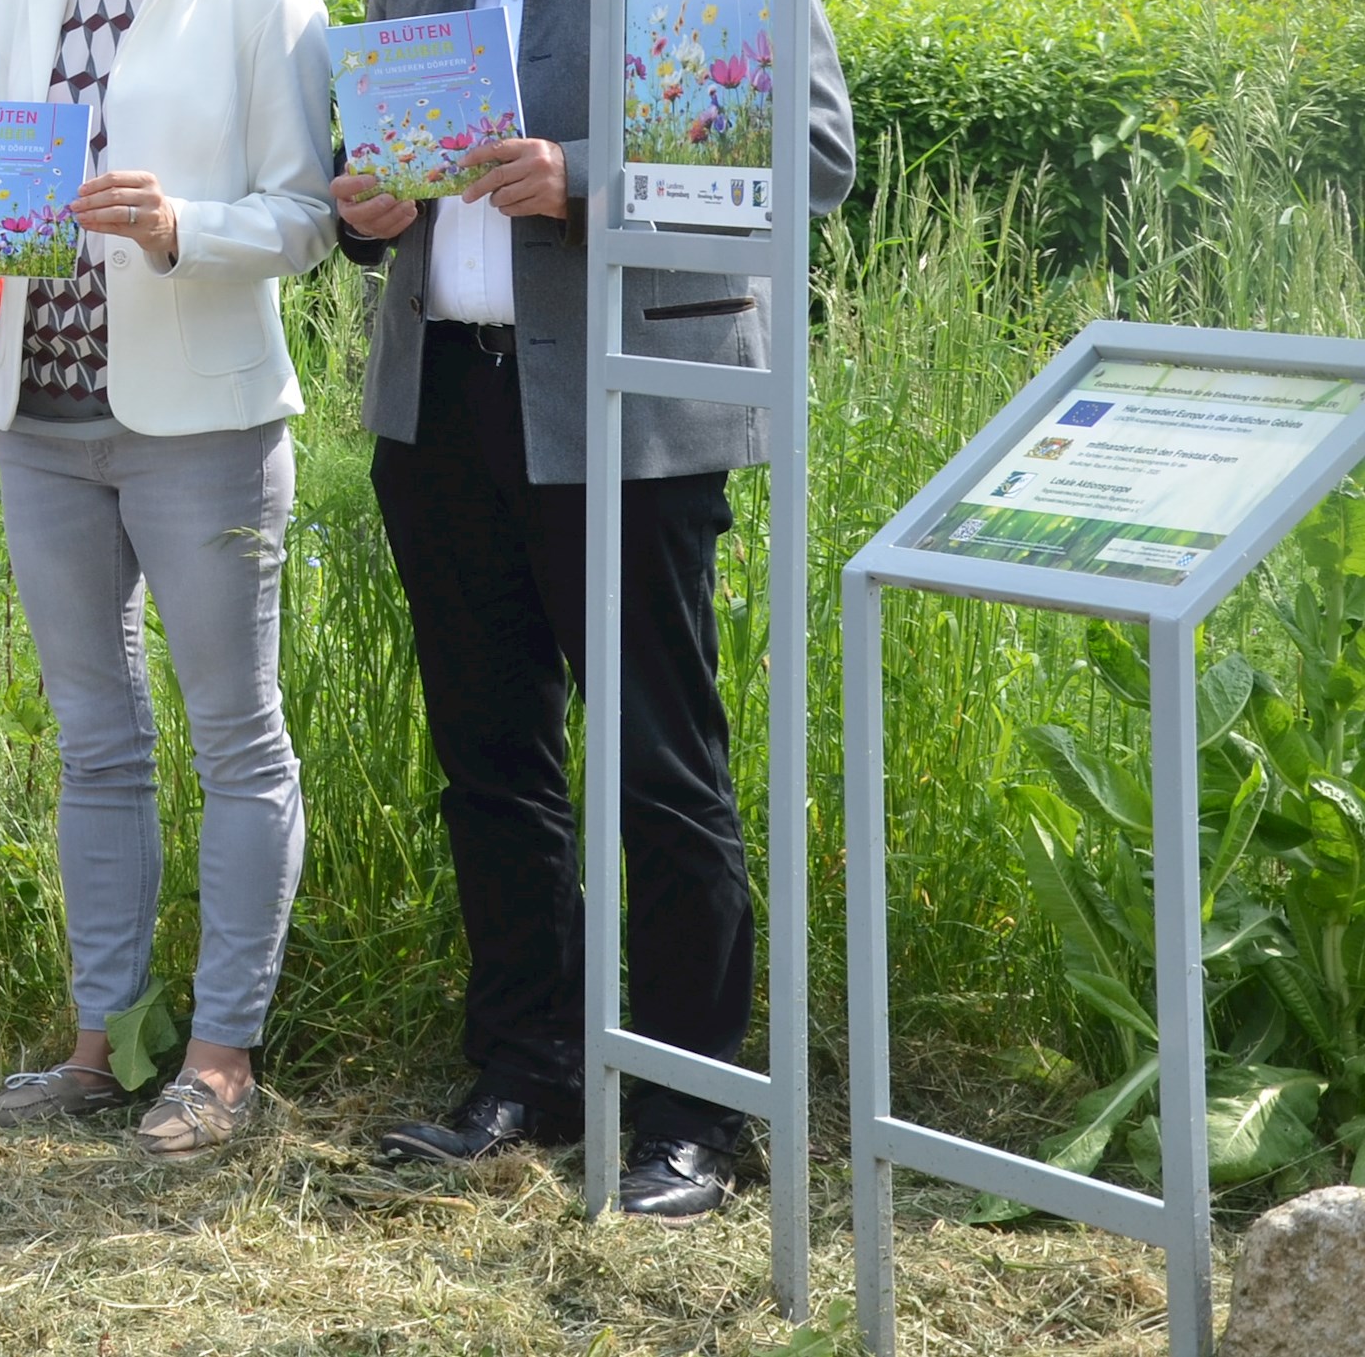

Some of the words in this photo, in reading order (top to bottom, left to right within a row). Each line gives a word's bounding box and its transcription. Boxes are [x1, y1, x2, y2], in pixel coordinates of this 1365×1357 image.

[379, 23, 452, 44] BLÜTEN
[384, 40, 454, 62] ZAUBER
[386, 64, 424, 74] UNSEREN
[426, 58, 467, 69] DÖRFERN
[8, 144, 44, 154] DÖRFERN
[1122, 404, 1140, 413] Hier
[1140, 406, 1177, 416] investiert
[1176, 410, 1206, 420] Europa
[1214, 414, 1228, 422] die
[1228, 414, 1270, 426] ländlichen
[1270, 418, 1303, 429] Gebiete
[1086, 441, 1134, 454] mitfinanziert
[1134, 445, 1158, 456] durch
[1157, 448, 1174, 458] den
[1173, 449, 1210, 461] Freistaat
[1208, 453, 1238, 464] Bayern
[1050, 476, 1076, 486] Lokale
[1076, 479, 1132, 493] Aktionsgruppe
